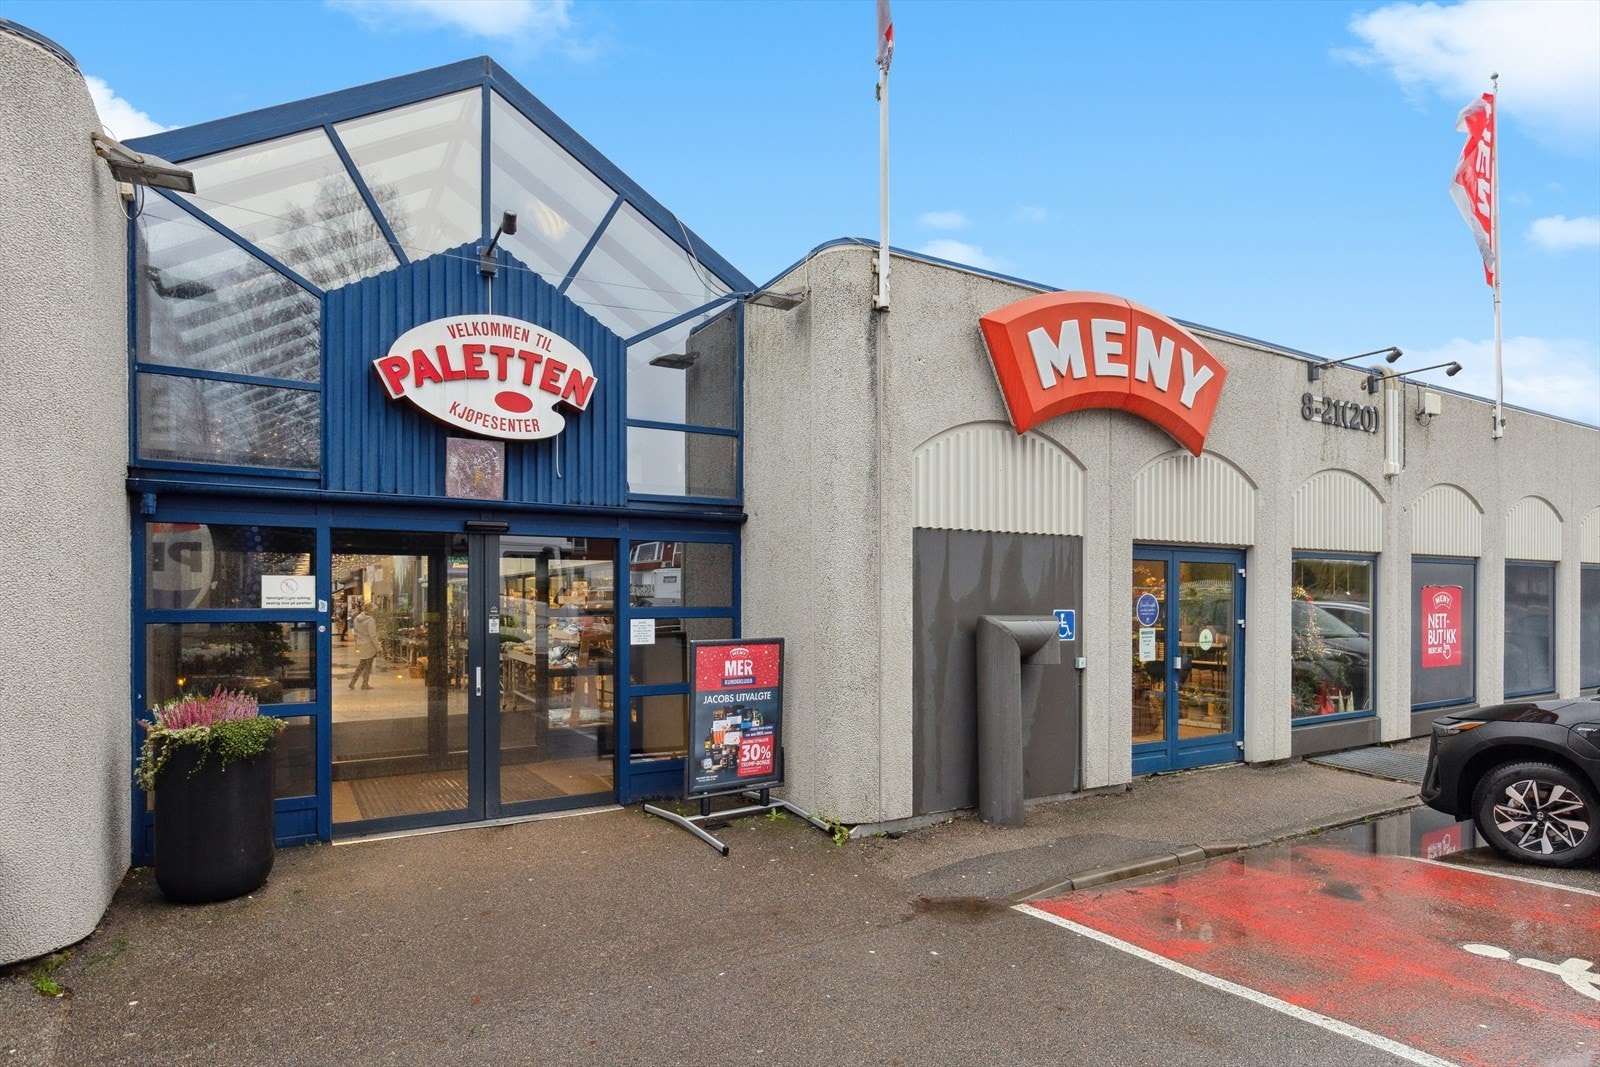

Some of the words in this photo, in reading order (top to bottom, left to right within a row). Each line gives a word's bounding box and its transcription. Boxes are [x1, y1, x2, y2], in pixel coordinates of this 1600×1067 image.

[447, 321, 530, 343] VELKOMMEN
[536, 333, 553, 352] TIL
[1027, 318, 1214, 409] MENY
[378, 343, 595, 407] PALETTEN
[449, 401, 540, 433] KJØPESENTER
[1301, 392, 1380, 434] 8-21(20)
[1435, 594, 1450, 605] MENY
[1428, 613, 1450, 629] NETT-
[1428, 629, 1456, 645] BUTIKK
[724, 659, 753, 677] MER
[703, 693, 734, 705] JACOBS
[735, 691, 772, 702] UTVALGTE
[741, 743, 771, 762] 30%
